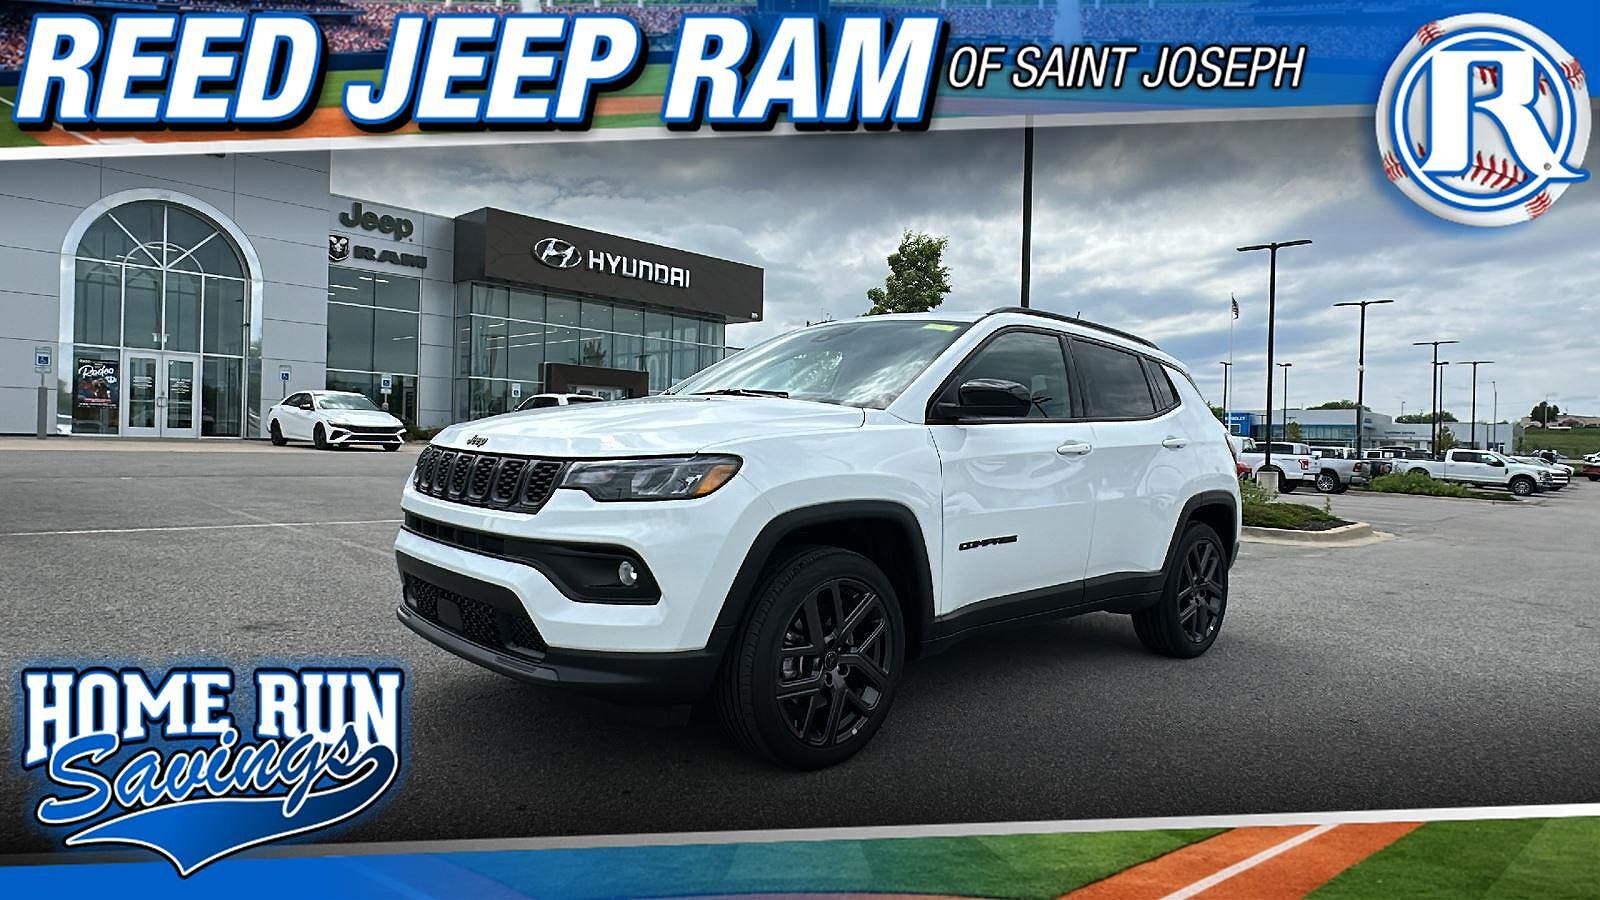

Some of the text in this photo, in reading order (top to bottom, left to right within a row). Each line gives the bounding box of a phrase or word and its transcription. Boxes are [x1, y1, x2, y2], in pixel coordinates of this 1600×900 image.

[339, 202, 414, 241] Jeep
[353, 245, 428, 269] RAM
[588, 249, 690, 288] HYUNDAI
[466, 434, 489, 448] Jeep
